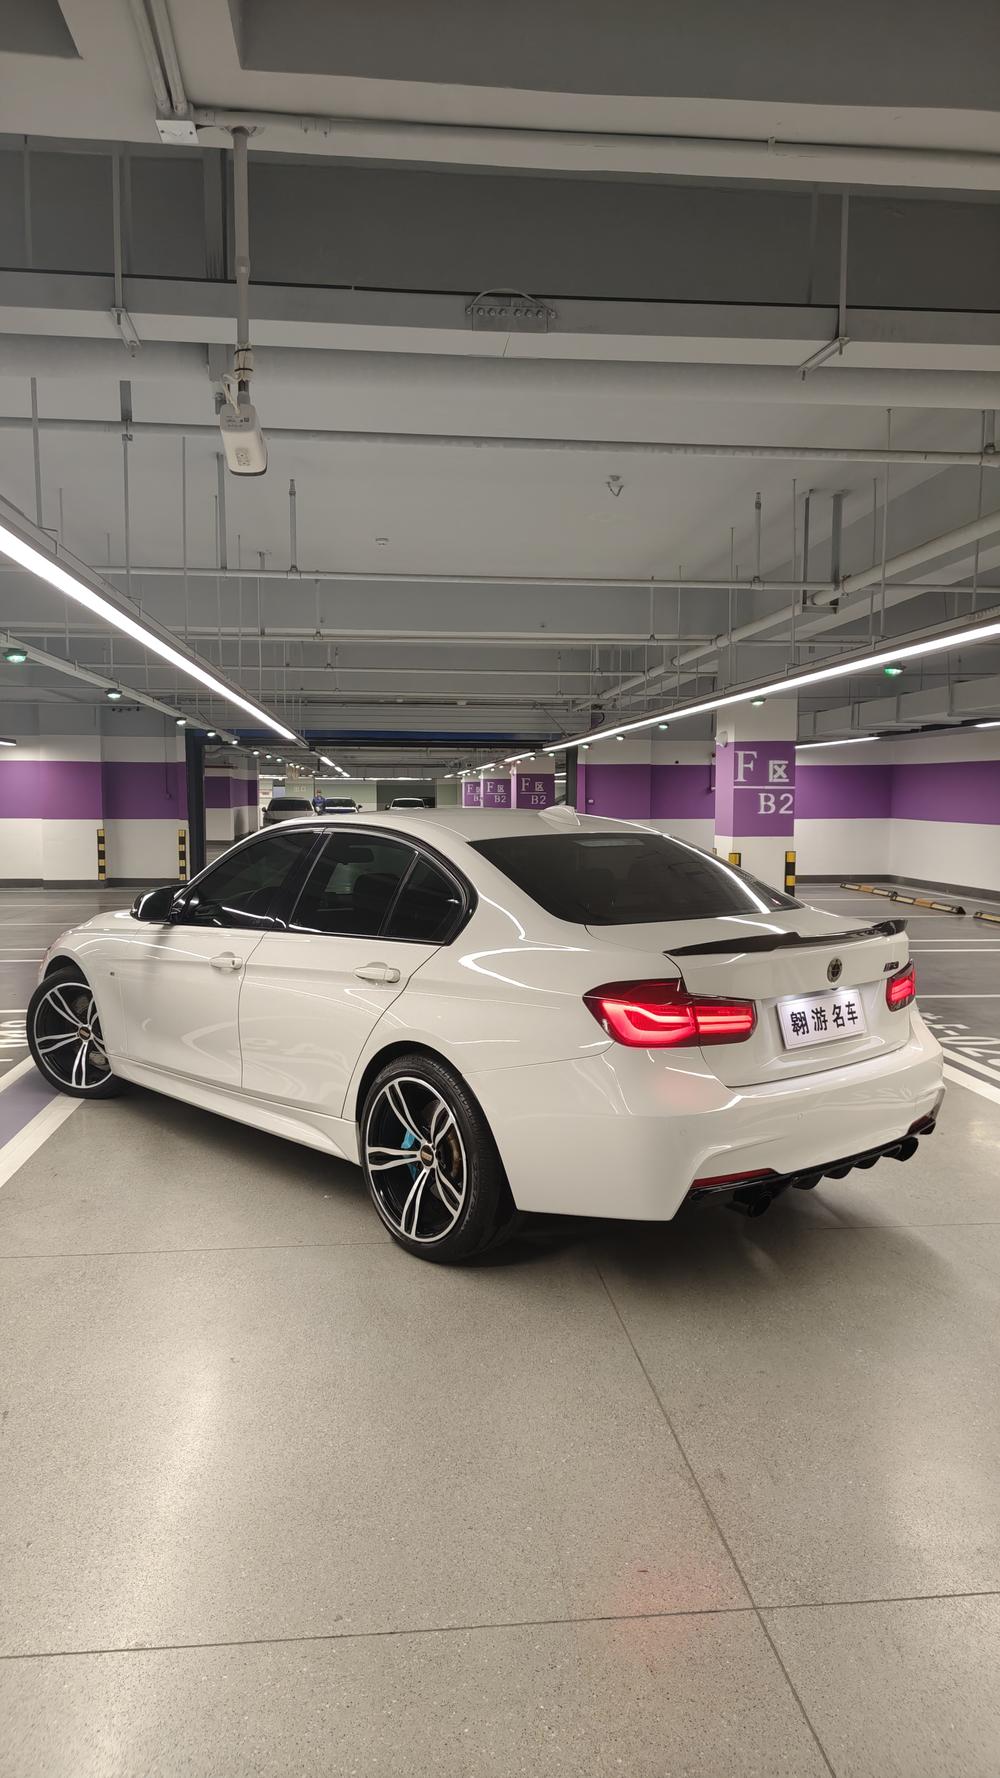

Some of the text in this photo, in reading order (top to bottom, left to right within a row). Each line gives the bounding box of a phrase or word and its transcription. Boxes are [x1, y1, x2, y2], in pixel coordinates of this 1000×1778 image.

[494, 795, 507, 803] B2
[531, 795, 546, 805] B2
[757, 793, 794, 814] B2
